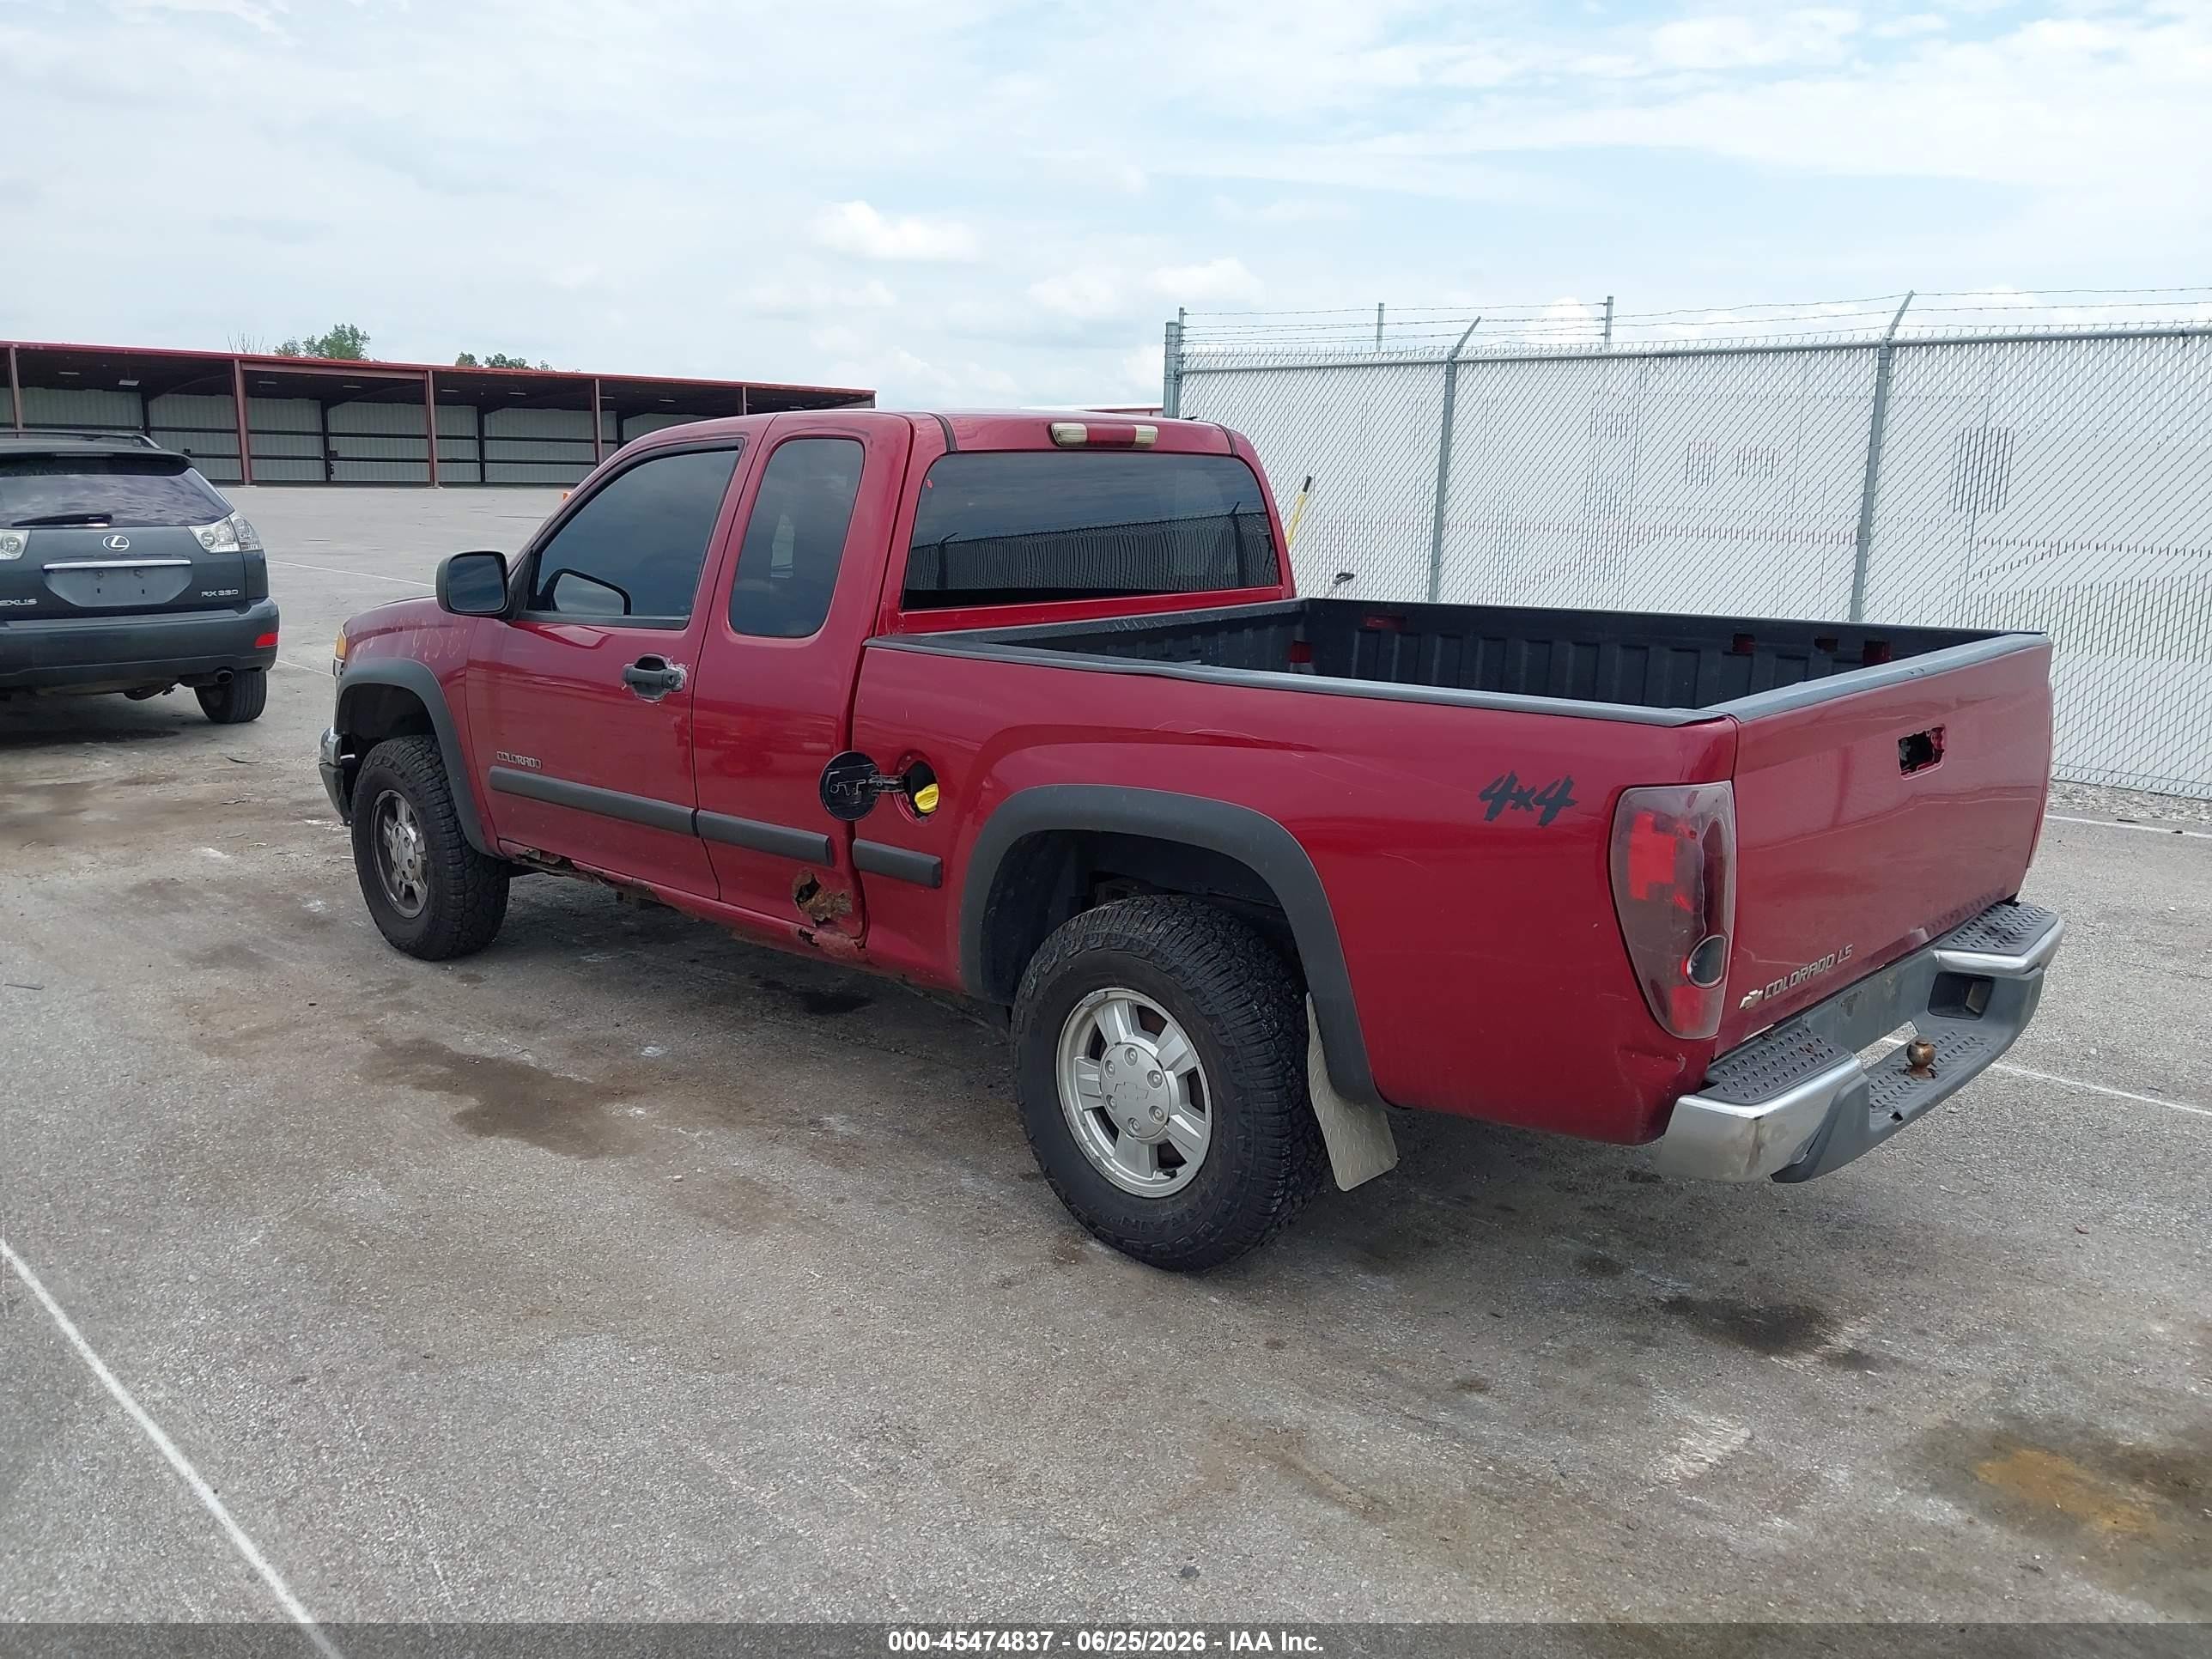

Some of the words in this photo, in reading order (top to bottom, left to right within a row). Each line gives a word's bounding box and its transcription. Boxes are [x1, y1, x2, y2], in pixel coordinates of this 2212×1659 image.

[496, 750, 542, 769] COLORADO
[1764, 953, 1836, 1000] COLORADO
[1836, 944, 1854, 965] LS
